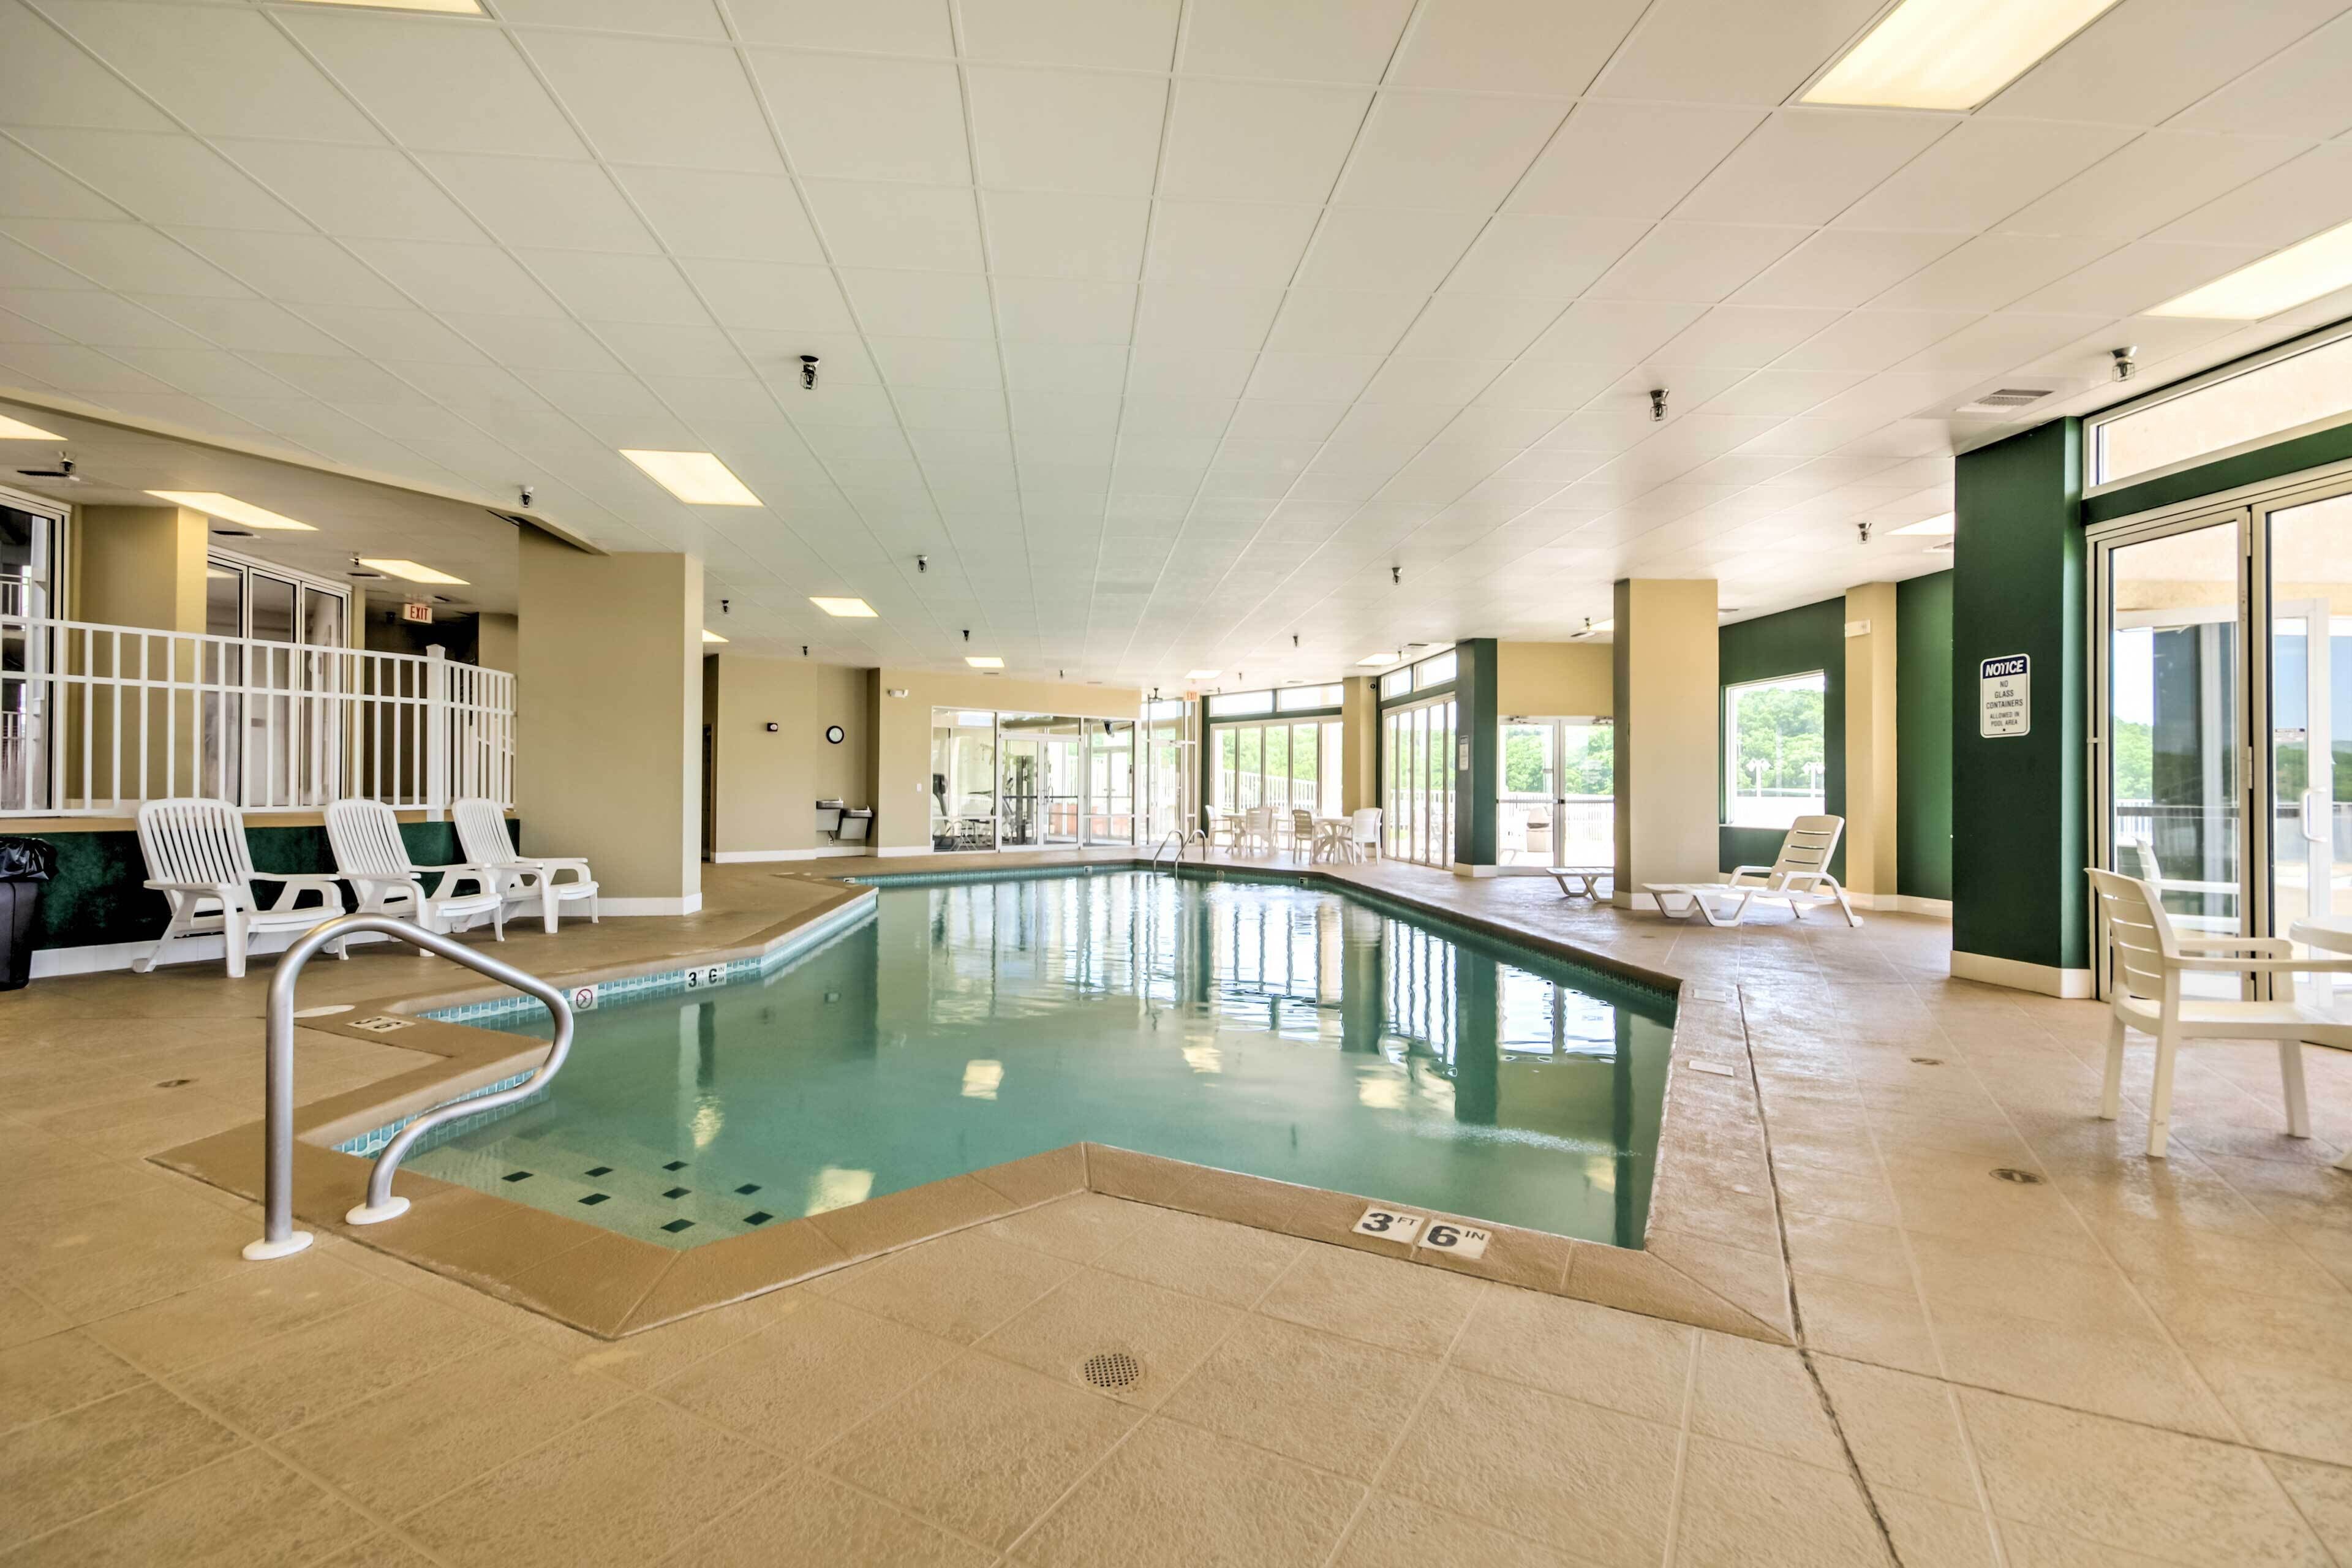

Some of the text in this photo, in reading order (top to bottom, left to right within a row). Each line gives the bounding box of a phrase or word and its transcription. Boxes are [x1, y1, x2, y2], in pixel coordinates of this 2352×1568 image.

[410, 606, 428, 620] EXIT
[1985, 660, 2024, 677] NOTICE
[1994, 690, 2014, 698] GLASS
[1986, 699, 2023, 709] CONTAINERS
[688, 971, 697, 987] 3
[1362, 1212, 1485, 1247] 3 FT 6 IN
